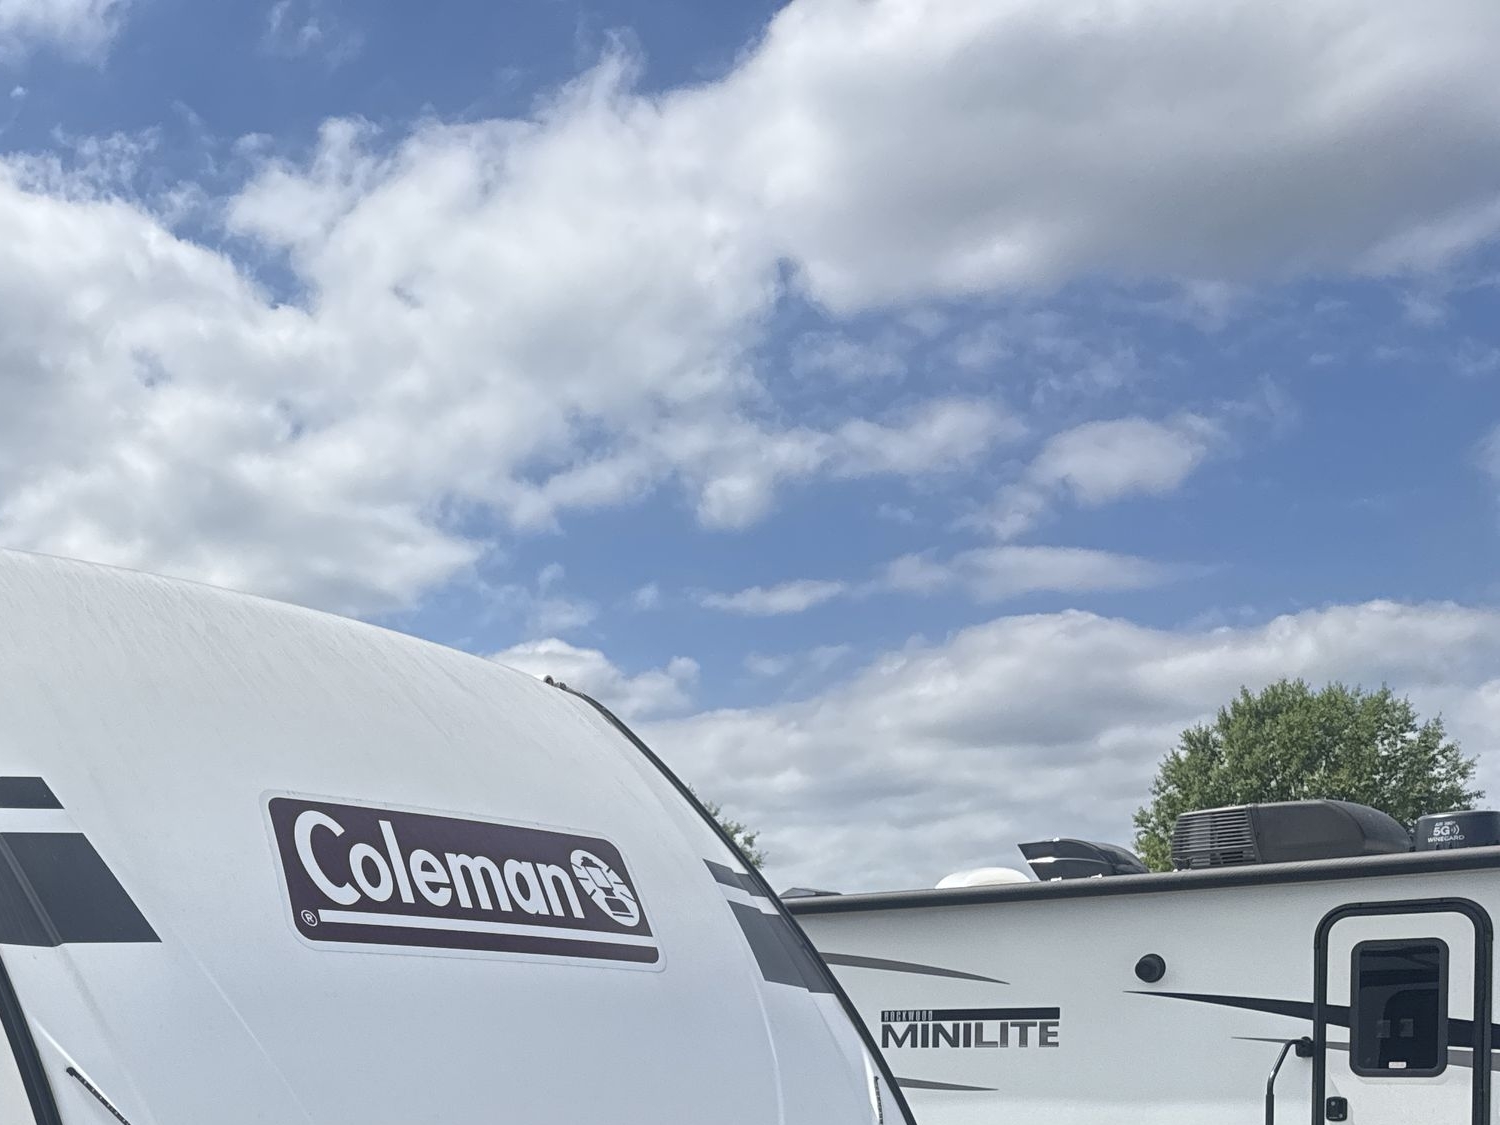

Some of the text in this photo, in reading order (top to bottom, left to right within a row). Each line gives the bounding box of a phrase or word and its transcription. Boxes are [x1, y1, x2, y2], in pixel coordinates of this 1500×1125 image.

[1433, 825, 1451, 837] 5G
[293, 809, 585, 919] Coleman
[883, 1010, 933, 1022] ROCKWOOD
[881, 1021, 1060, 1049] MINILITE
